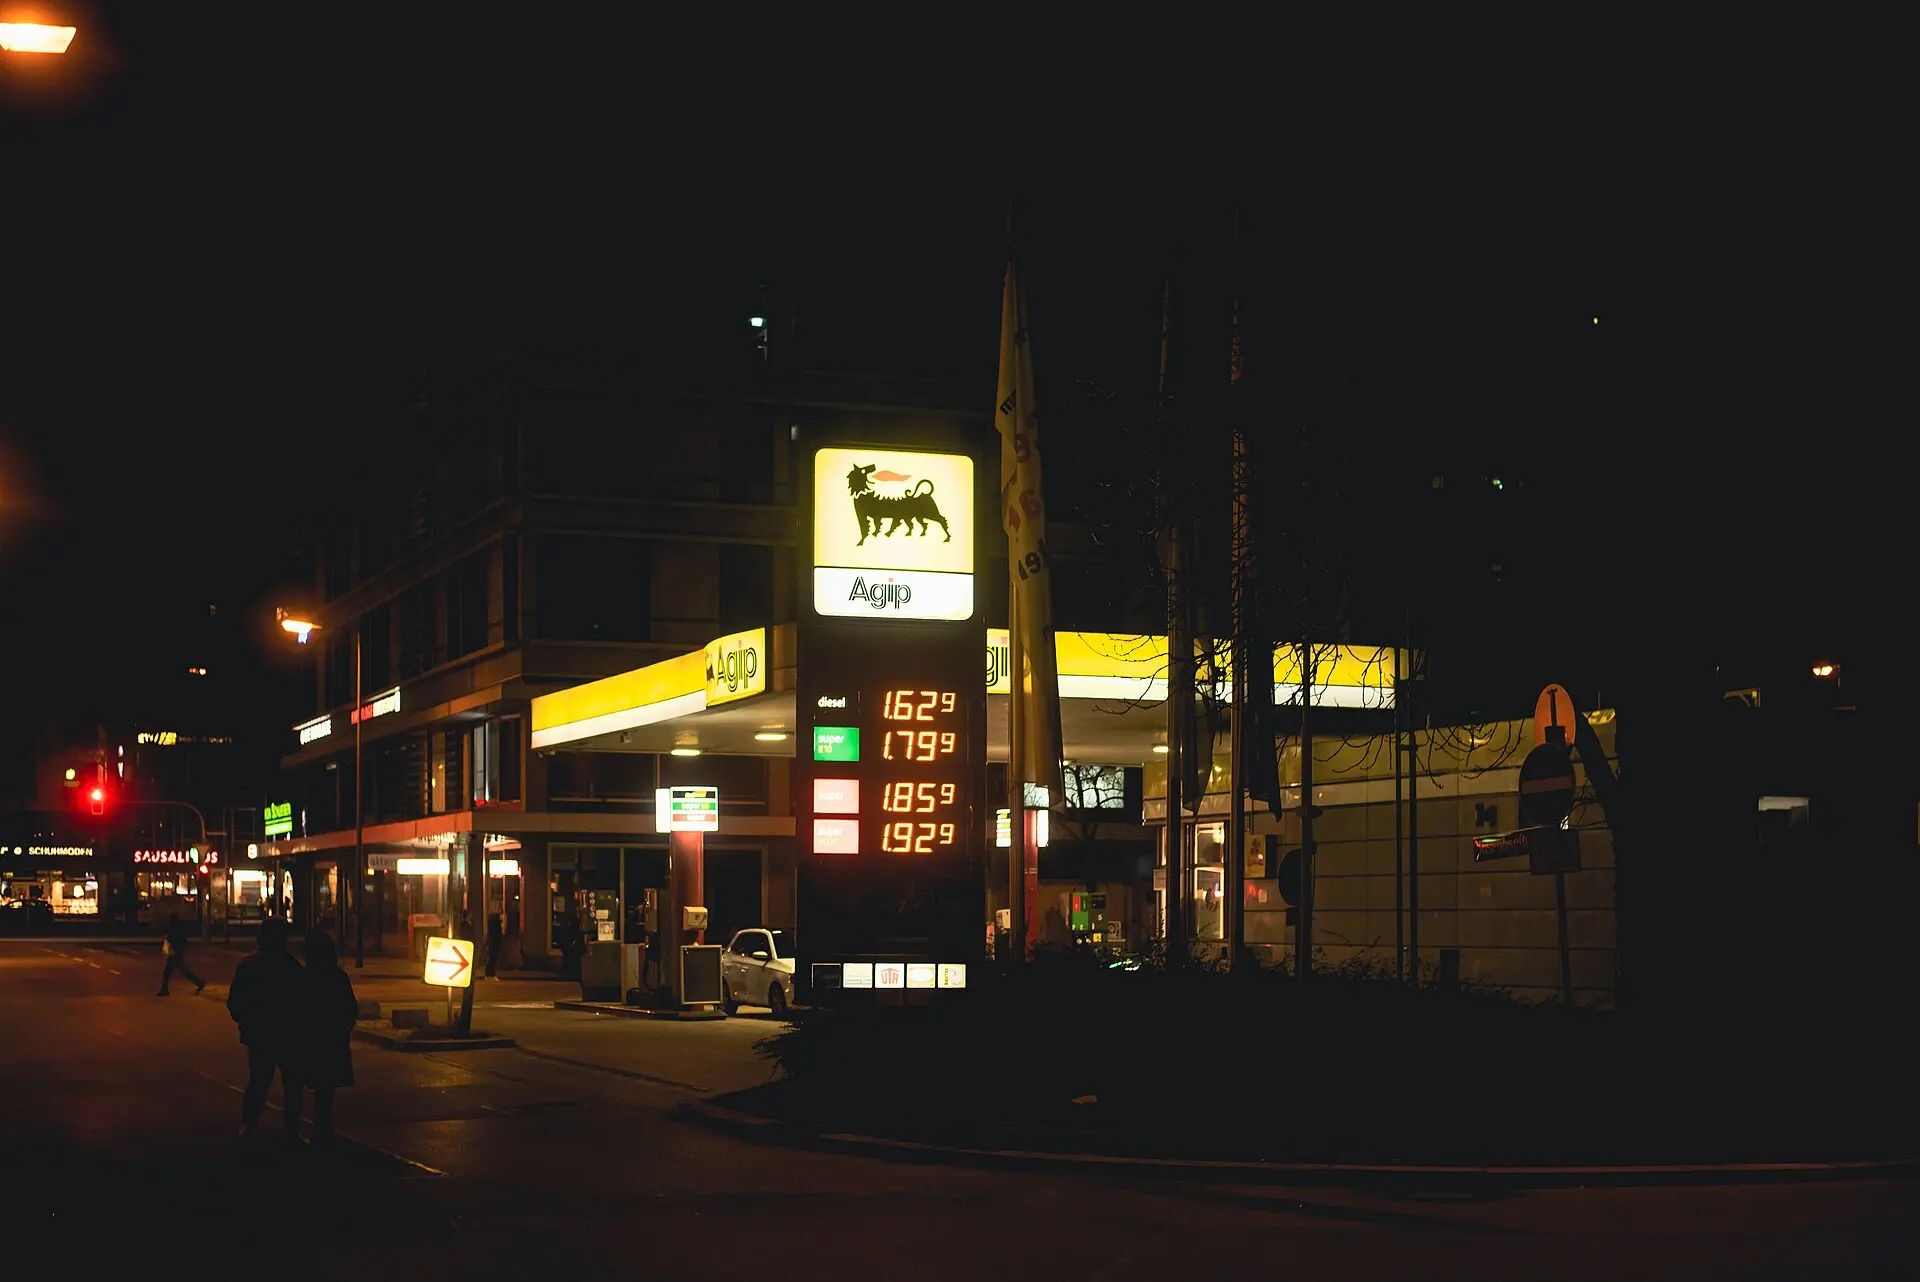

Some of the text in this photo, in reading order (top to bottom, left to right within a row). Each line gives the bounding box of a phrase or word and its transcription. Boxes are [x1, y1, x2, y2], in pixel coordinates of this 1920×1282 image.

[848, 576, 912, 610] Agip
[716, 640, 758, 693] Agip
[817, 696, 846, 708] diesel
[817, 735, 845, 746] super
[818, 791, 845, 802] super
[817, 827, 845, 838] super
[133, 847, 218, 864] SAUSALIS
